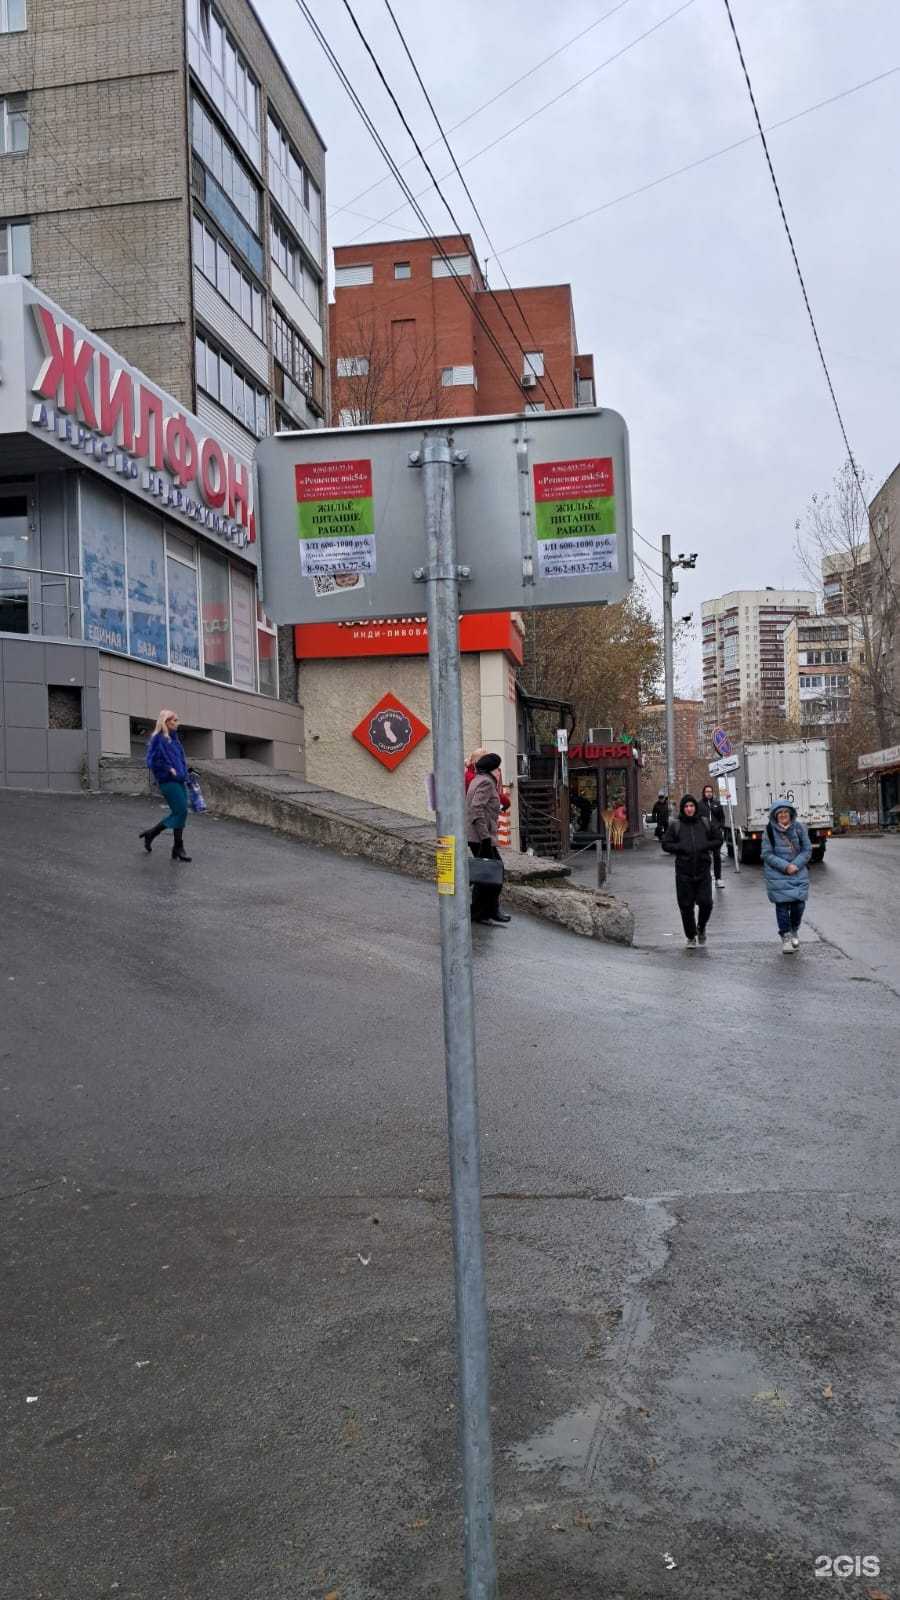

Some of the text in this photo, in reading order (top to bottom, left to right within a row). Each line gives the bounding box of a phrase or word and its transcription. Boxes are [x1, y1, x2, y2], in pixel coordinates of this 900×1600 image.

[317, 500, 354, 513] ЖИЛЬЁ
[555, 500, 594, 513] ЖИЛЬЁ
[312, 512, 361, 525] ПИТАНИЕ
[551, 512, 601, 525] ПИТАНИЕ
[318, 525, 356, 535] РАБОТА
[556, 525, 596, 536] РАБОТА
[353, 628, 428, 639] ИНДИ-ПИВОВА
[568, 745, 630, 760] ИШНЯ
